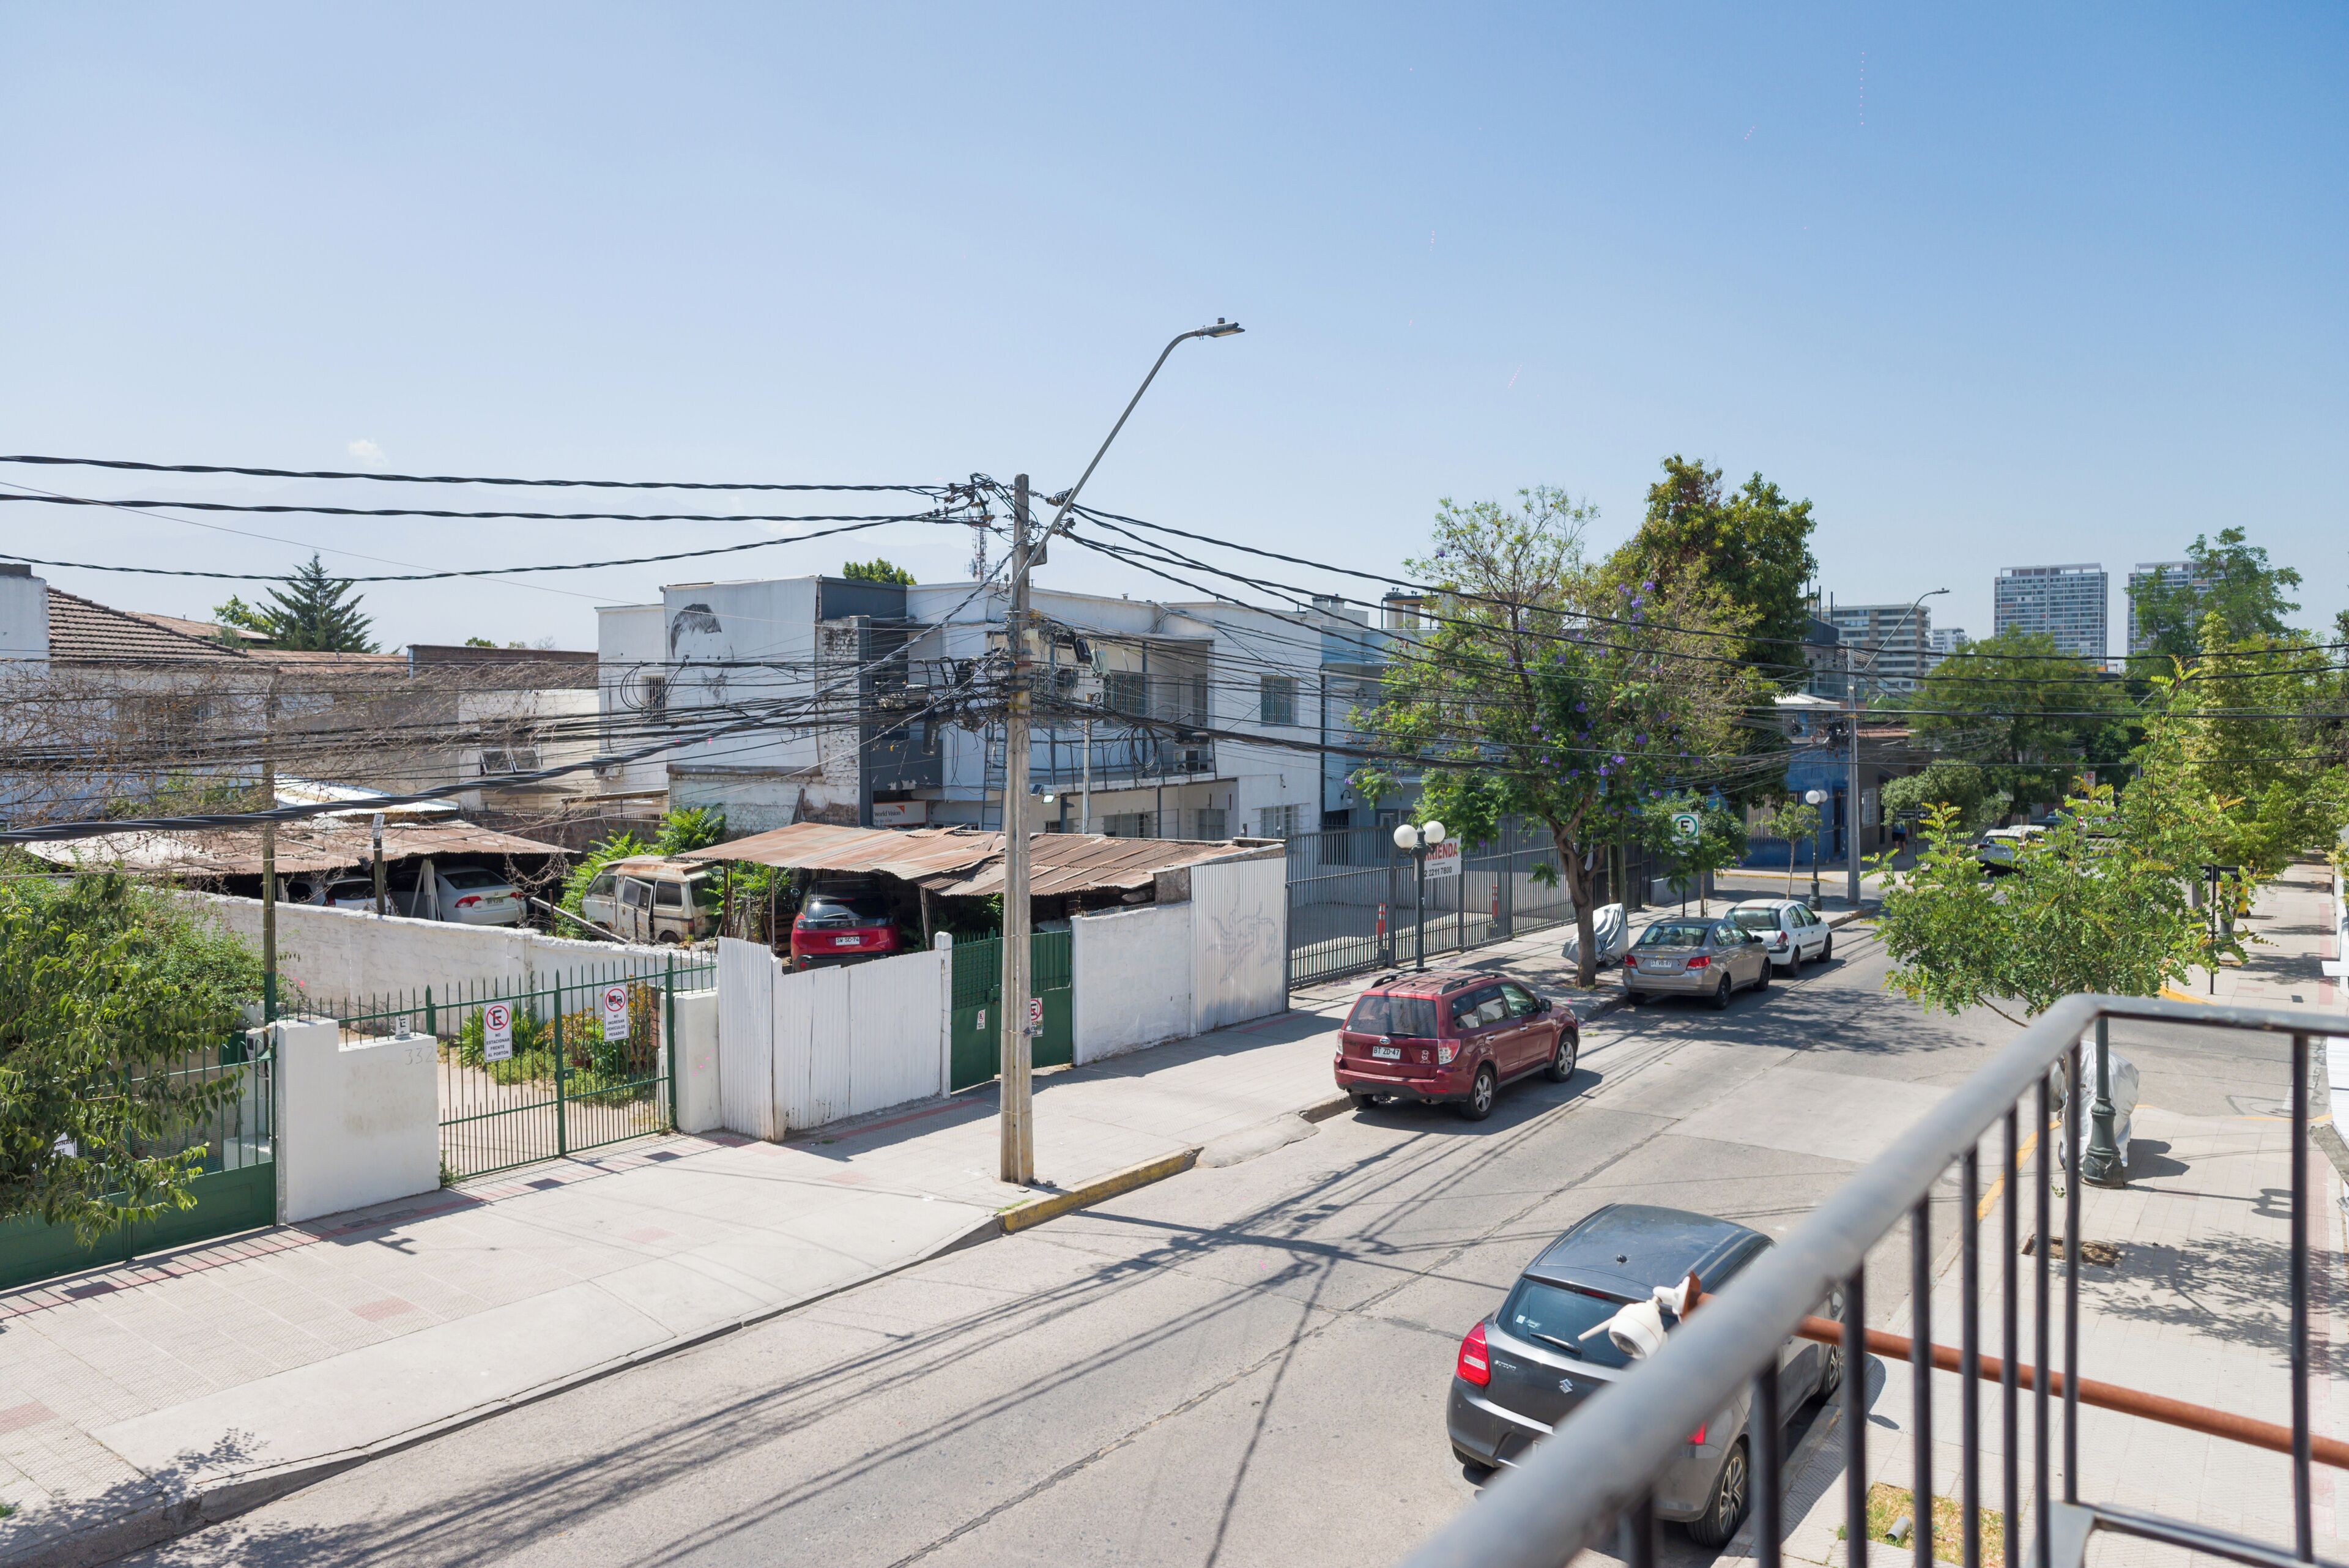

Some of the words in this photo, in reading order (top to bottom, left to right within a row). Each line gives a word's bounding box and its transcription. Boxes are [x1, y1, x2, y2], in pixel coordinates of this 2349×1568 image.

[1681, 820, 1690, 833] E
[1429, 868, 1440, 877] 2211
[1441, 866, 1452, 874] 7800
[404, 1046, 434, 1066] 332
